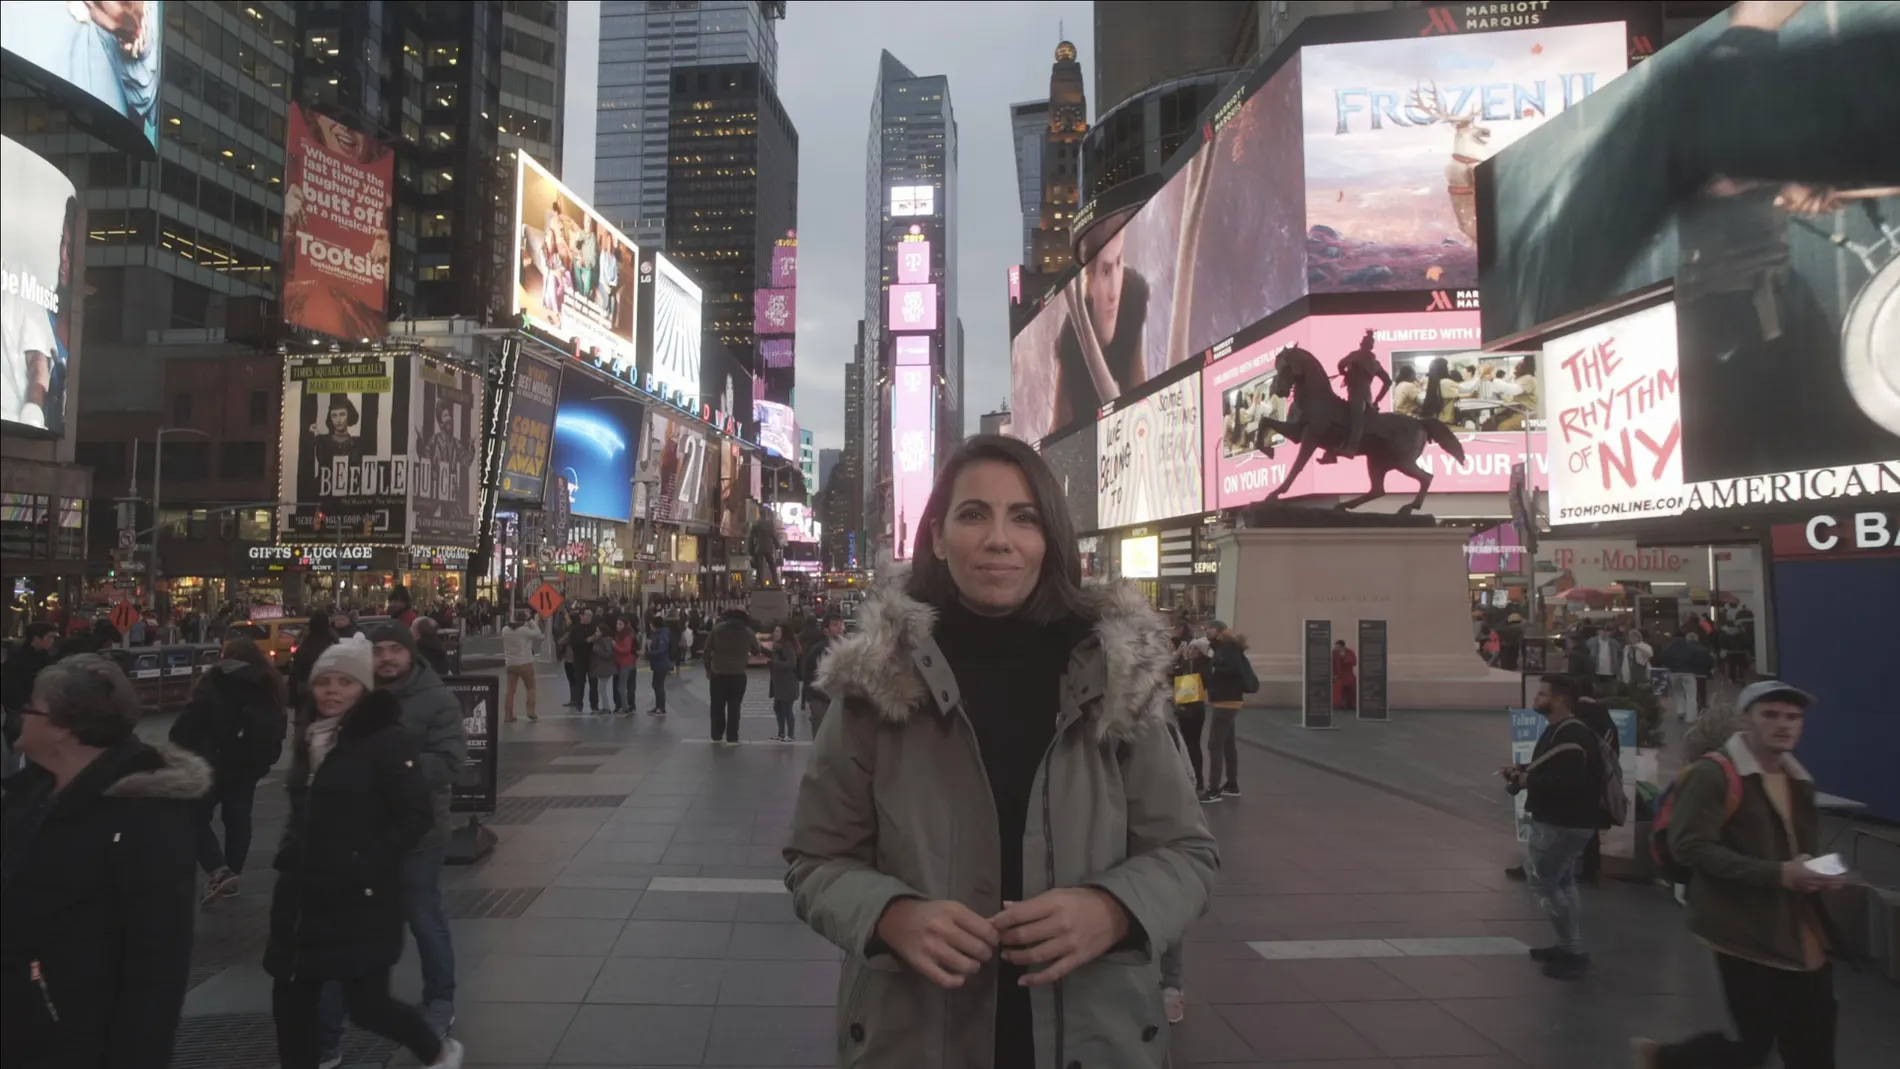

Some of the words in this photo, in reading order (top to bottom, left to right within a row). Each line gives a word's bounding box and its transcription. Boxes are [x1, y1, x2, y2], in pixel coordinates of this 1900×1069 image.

[1465, 0, 1550, 17] MARRIOTT
[1466, 13, 1540, 30] MARQUIS
[1214, 85, 1246, 121] MARRIOTT
[1214, 101, 1242, 133] MARQUIS
[1333, 79, 1547, 136] FROZEN
[302, 167, 356, 198] laughed
[357, 191, 385, 210] your
[303, 155, 328, 176] last
[332, 167, 360, 188] time
[362, 182, 384, 198] you
[343, 163, 364, 180] was
[366, 172, 385, 188] the
[302, 181, 351, 215] butt
[353, 205, 384, 227] off
[306, 202, 318, 215] at
[320, 209, 328, 219] a
[295, 229, 385, 281] Tootsie
[20, 271, 59, 314] Music
[640, 275, 652, 283] LG
[1373, 328, 1437, 342] NLIMITED
[1440, 327, 1473, 340] WITH
[292, 364, 314, 378] TIMES
[315, 364, 341, 378] SQUARE
[342, 364, 357, 376] CAN
[357, 362, 384, 374] REALLY
[1560, 336, 1624, 393] THE
[331, 380, 344, 391] YOU
[347, 379, 364, 390] FEEL
[645, 372, 743, 439] BROADWAY
[1158, 390, 1183, 412] SOME
[1166, 406, 1197, 426] THING
[512, 415, 549, 443] COME
[1106, 419, 1122, 449] WE
[505, 453, 545, 477] AWAY
[678, 435, 706, 505] 21
[1099, 442, 1132, 495] BELONG
[1440, 453, 1512, 476] YOUR
[1568, 445, 1593, 474] OF
[1598, 419, 1681, 491] NY
[319, 455, 407, 497] BEETLE
[1223, 474, 1238, 494] ON
[1239, 467, 1269, 491] YOUR
[1270, 463, 1286, 485] TV
[1110, 489, 1123, 507] TO
[1805, 514, 1839, 551] C
[249, 547, 292, 559] GIFTS
